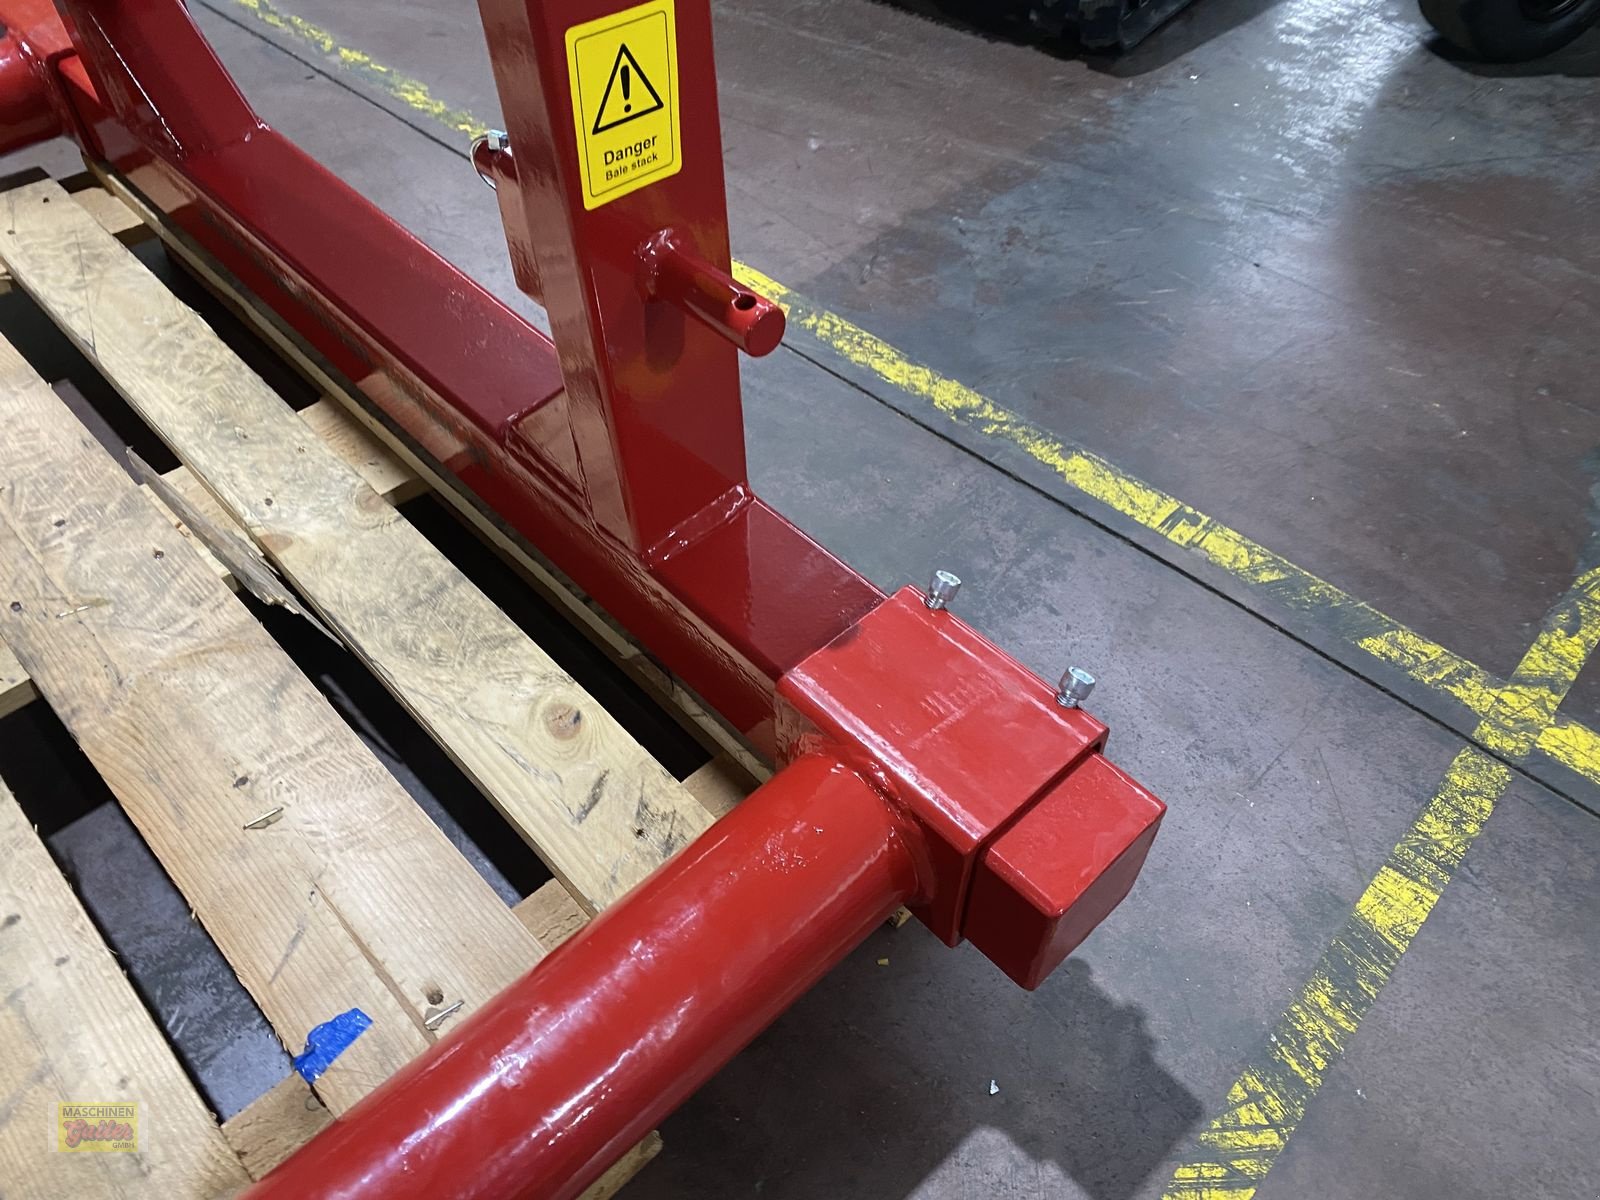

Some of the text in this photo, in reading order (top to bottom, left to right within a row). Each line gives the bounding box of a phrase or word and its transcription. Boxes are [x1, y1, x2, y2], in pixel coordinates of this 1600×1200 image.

[604, 135, 657, 166] Danger
[606, 152, 658, 181] Bale stack
